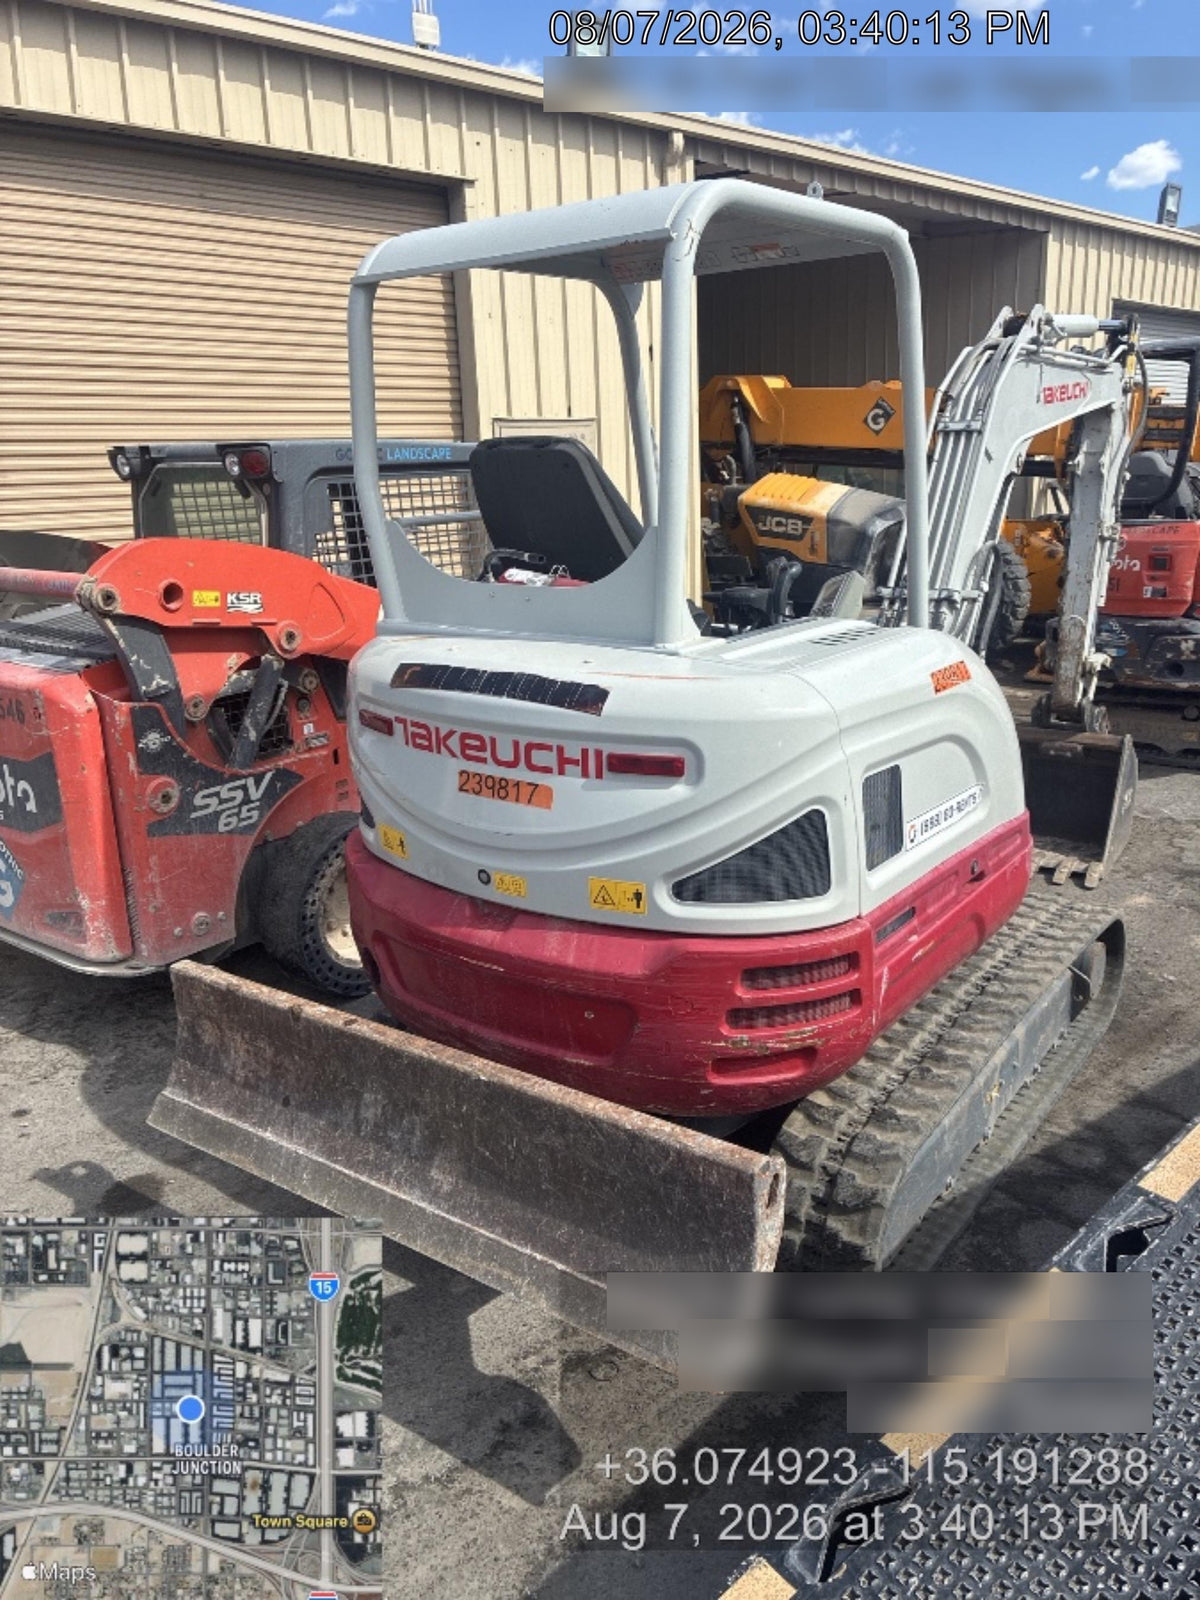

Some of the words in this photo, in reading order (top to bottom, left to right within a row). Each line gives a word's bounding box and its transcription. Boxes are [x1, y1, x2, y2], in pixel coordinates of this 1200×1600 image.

[386, 447, 452, 460] LANDSCAPE
[757, 515, 803, 535] JCB
[227, 591, 262, 604] KSR
[190, 770, 276, 819] SSV
[458, 769, 539, 804] 239817
[218, 801, 261, 832] 65
